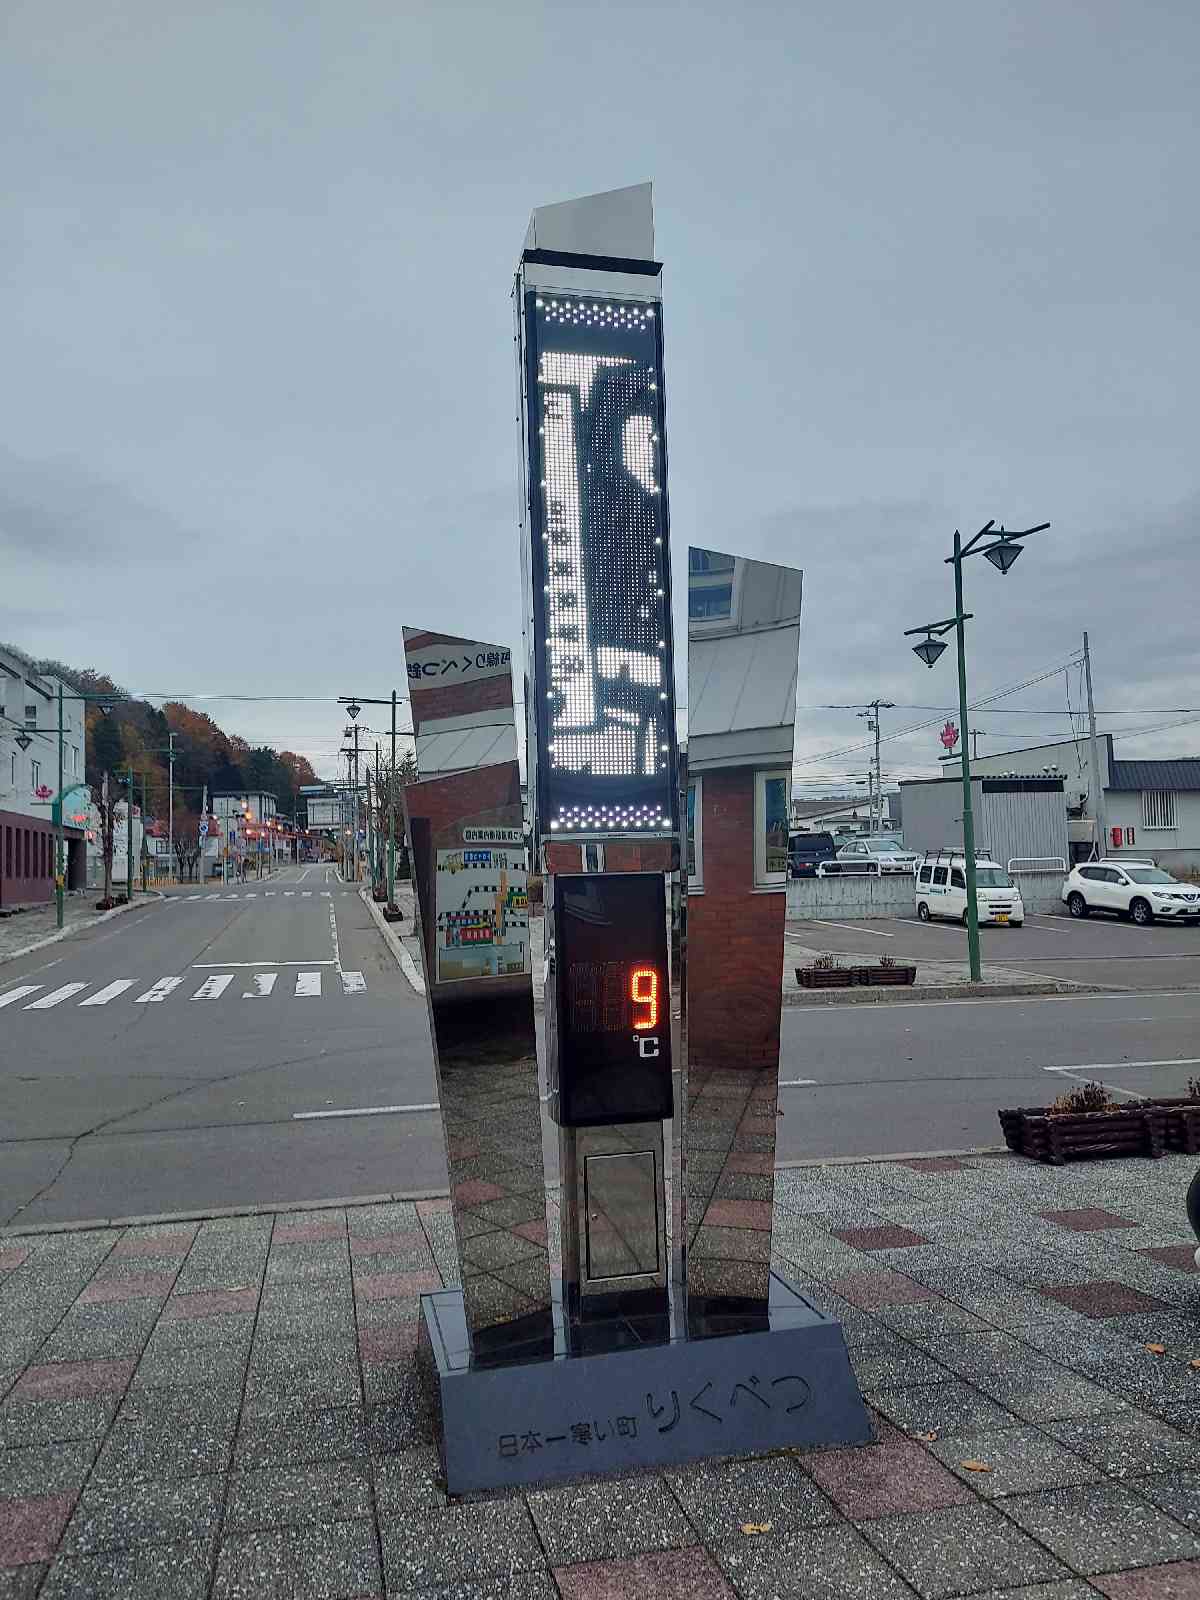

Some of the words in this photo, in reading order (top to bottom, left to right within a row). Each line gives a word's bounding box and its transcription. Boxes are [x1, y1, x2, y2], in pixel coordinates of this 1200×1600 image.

[632, 969, 658, 1030] 9
[499, 1416, 638, 1458] 日本一寒い町
[647, 1376, 810, 1433] りくべつ
